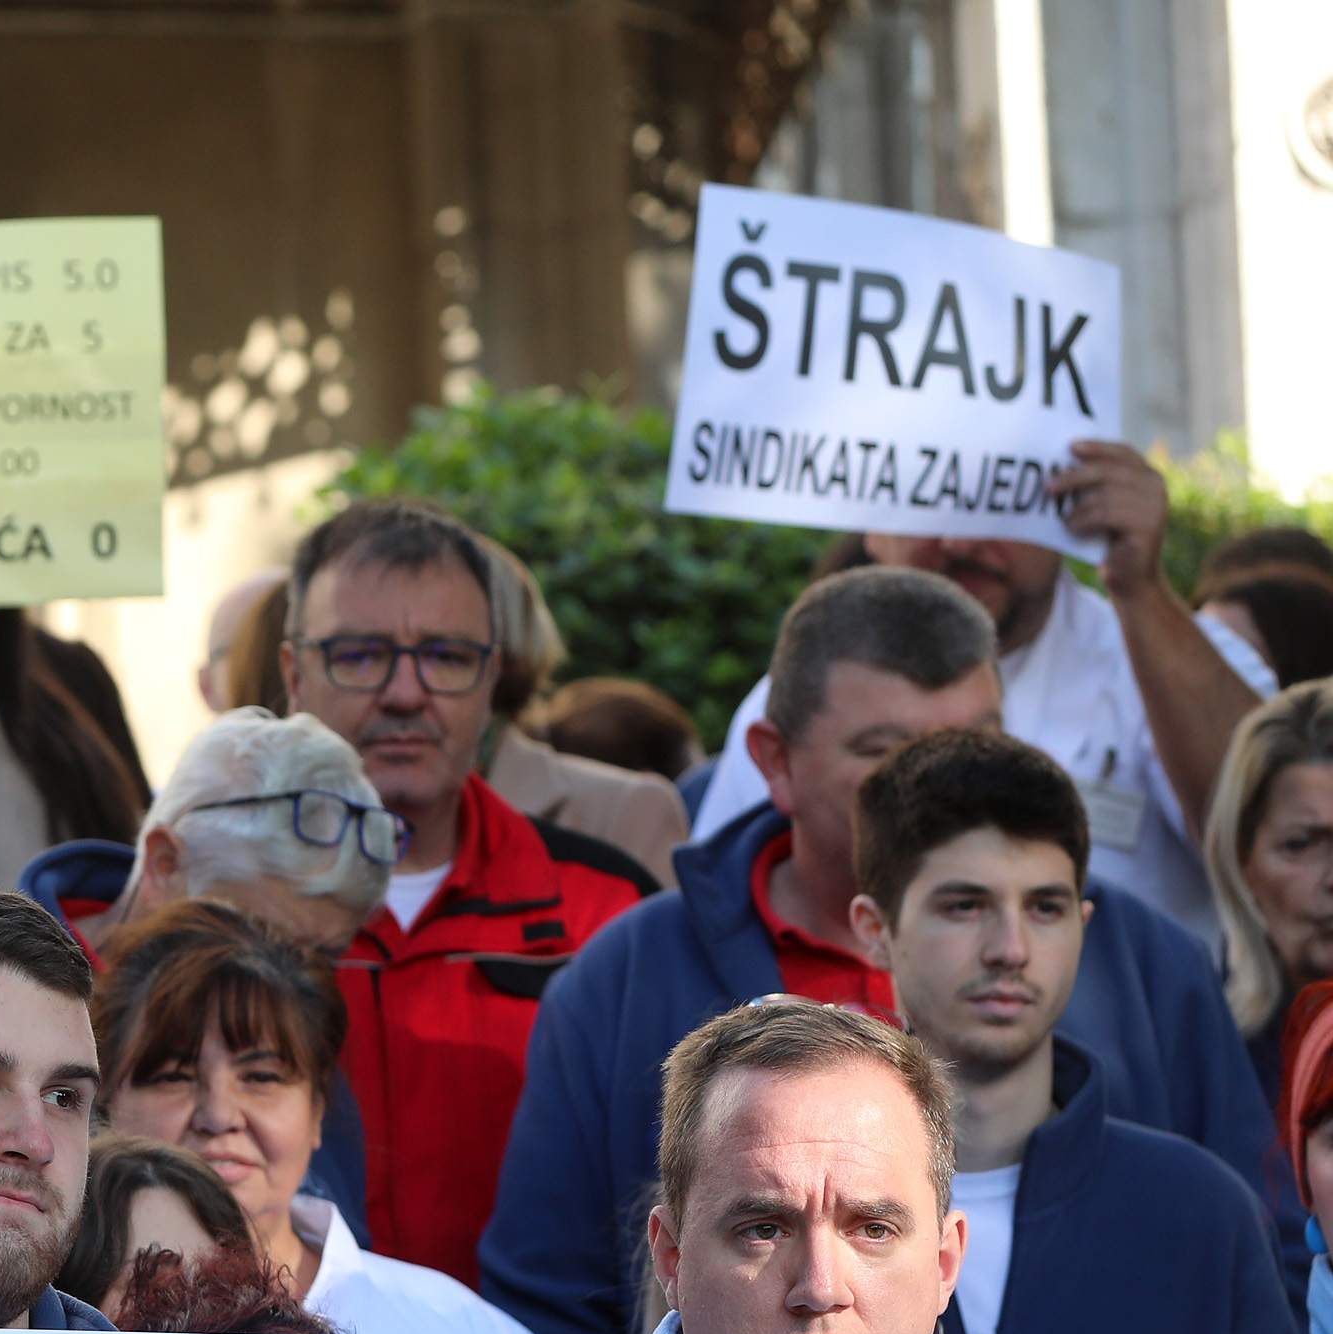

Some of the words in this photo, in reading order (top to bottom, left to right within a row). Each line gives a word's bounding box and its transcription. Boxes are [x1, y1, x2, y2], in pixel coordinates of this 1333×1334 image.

[62, 258, 120, 293] 5.0
[5, 321, 51, 354] ZA
[82, 319, 103, 352] 5
[714, 220, 1097, 419] ŠTRAJK
[687, 420, 898, 505] SINDIKATA
[92, 521, 117, 560] 0
